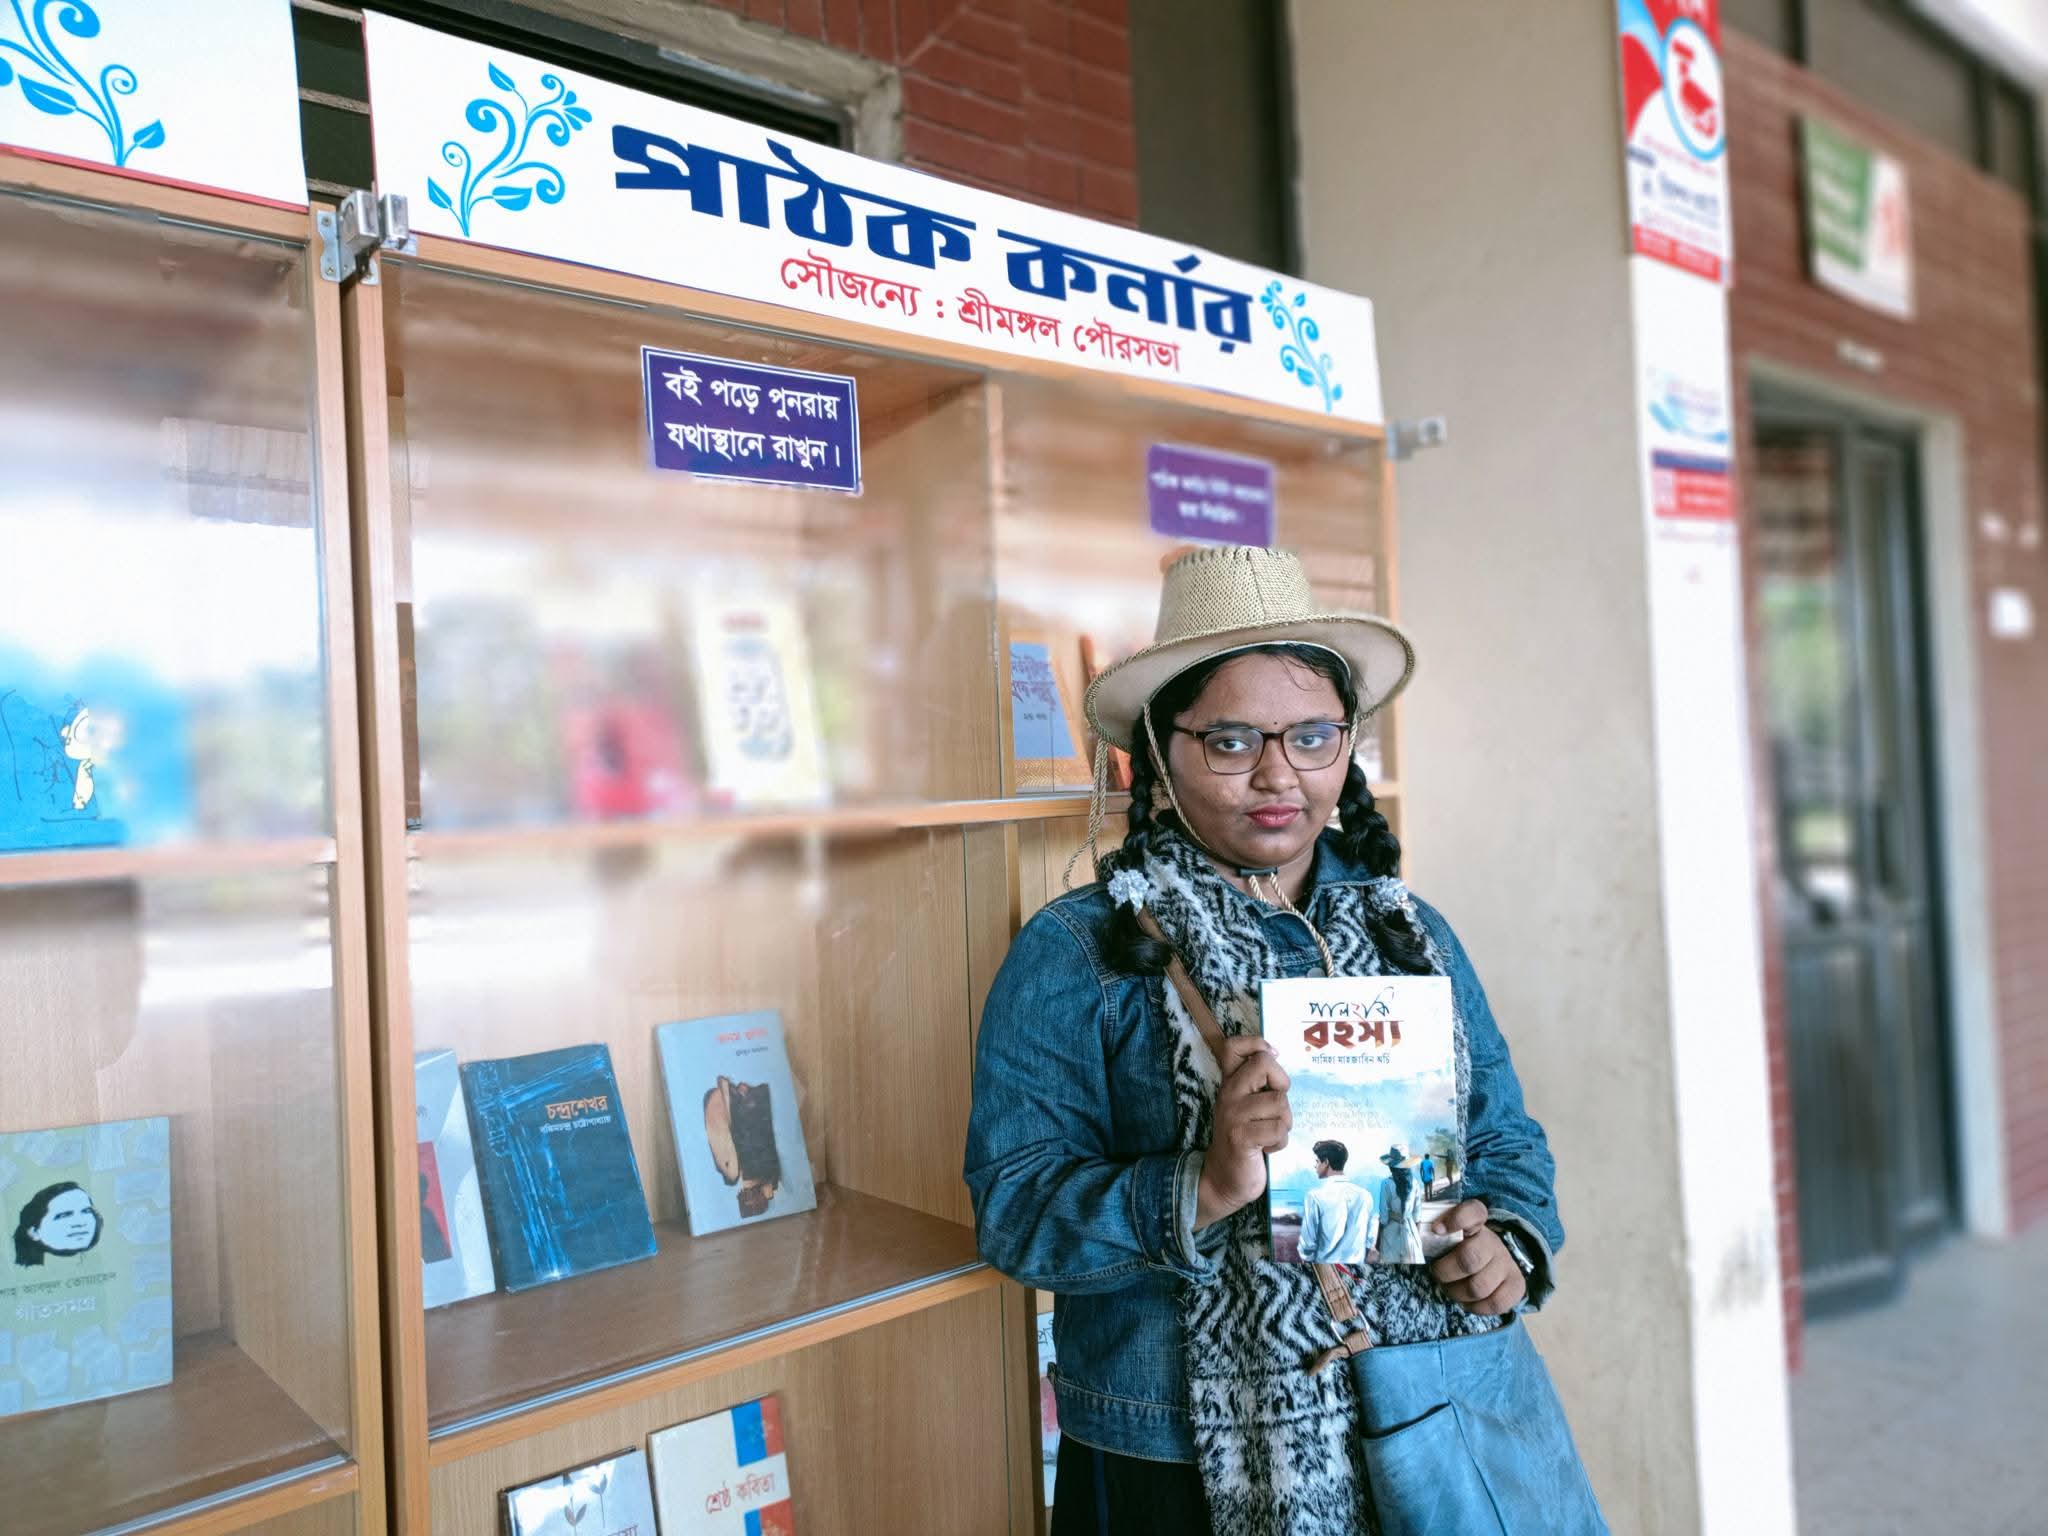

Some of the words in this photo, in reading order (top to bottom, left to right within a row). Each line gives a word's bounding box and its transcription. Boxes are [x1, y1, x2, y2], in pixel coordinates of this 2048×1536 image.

[612, 125, 976, 270] পাঠক
[997, 229, 1254, 354] কর্নার
[781, 250, 921, 316] সৌজন্যে
[957, 288, 1061, 347] শ্রীমঙ্গল
[1073, 316, 1181, 372] পৌরসভা
[662, 366, 703, 406] বই
[710, 378, 761, 415] পড়ে
[768, 387, 841, 422] পুনরায়
[664, 422, 766, 462] যথাস্থানে
[1303, 1020, 1401, 1052] রহস্য
[546, 1096, 607, 1120] চন্দ্রশেখর
[736, 1472, 777, 1502] কবিতা
